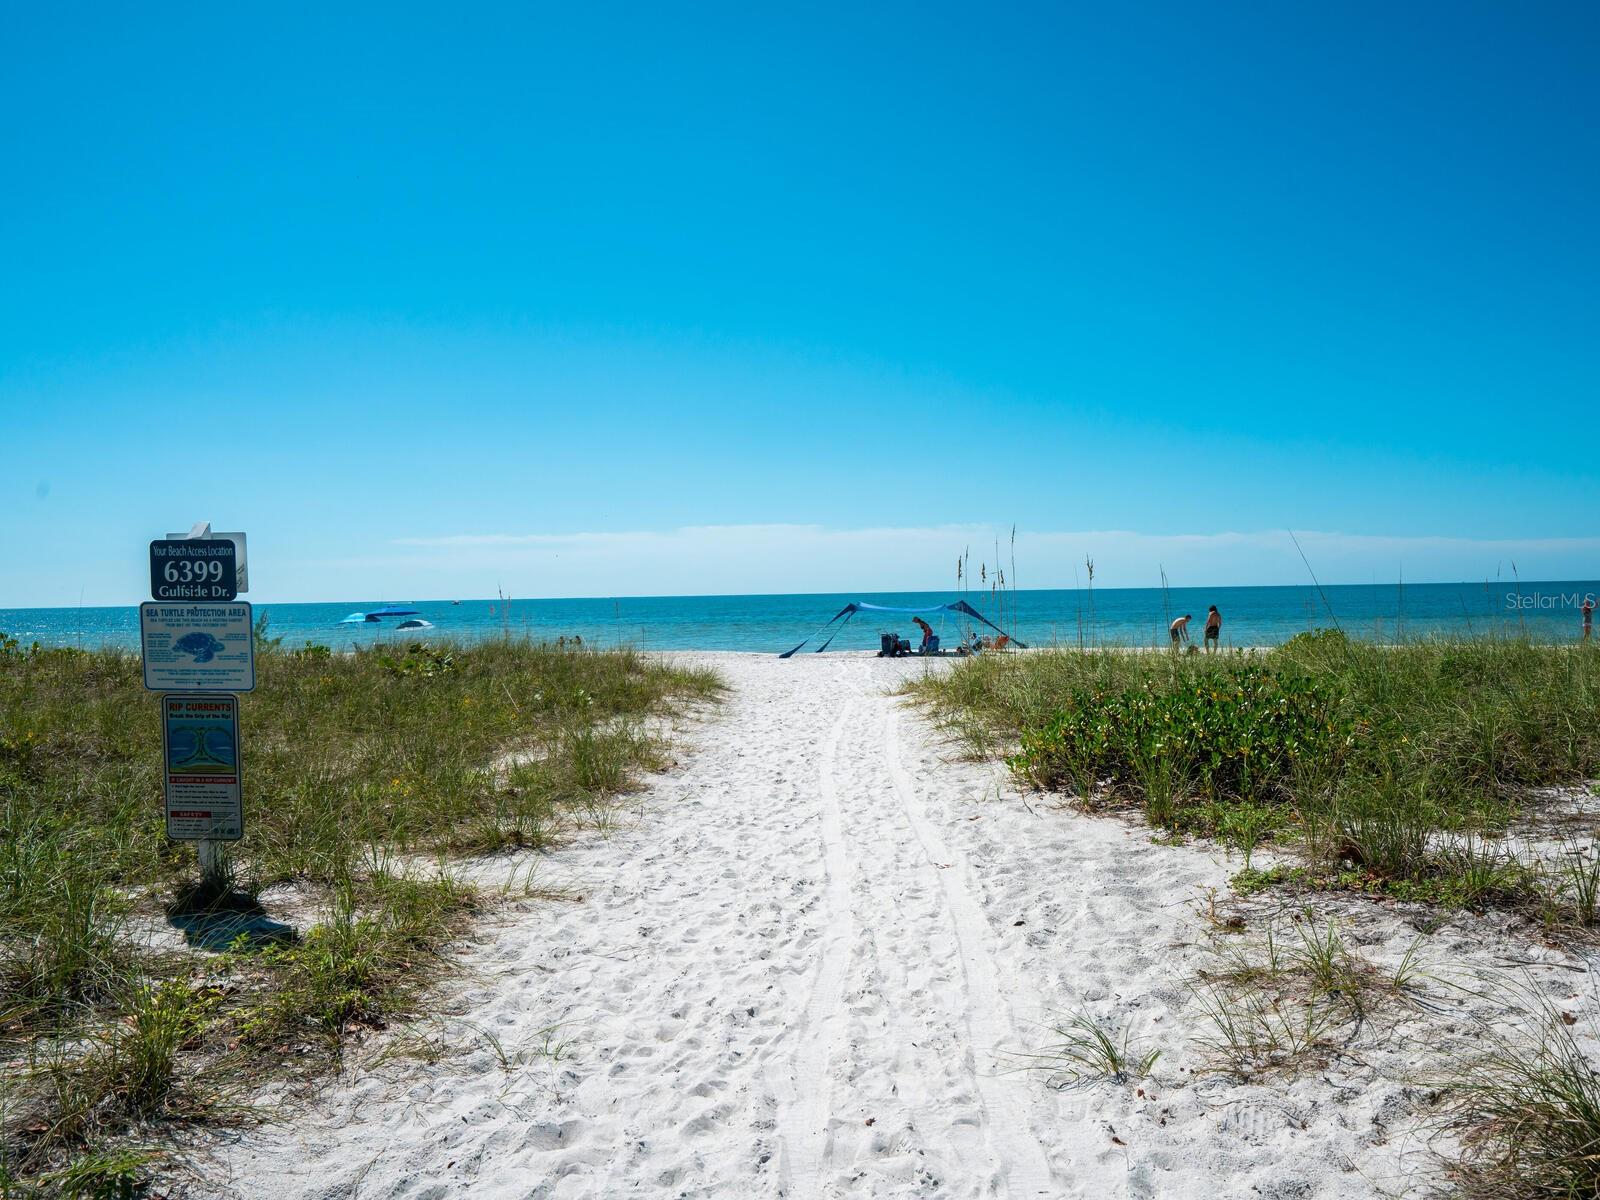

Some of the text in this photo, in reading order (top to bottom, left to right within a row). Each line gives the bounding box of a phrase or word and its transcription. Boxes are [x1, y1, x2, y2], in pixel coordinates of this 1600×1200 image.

[153, 545, 233, 557] Your Beach Access Location
[164, 560, 223, 583] 6399
[159, 585, 230, 598] Gulfside Dr.
[146, 608, 246, 617] SEA TURTLE PROTECTION AREA
[169, 703, 231, 712] RIP CURRENTS
